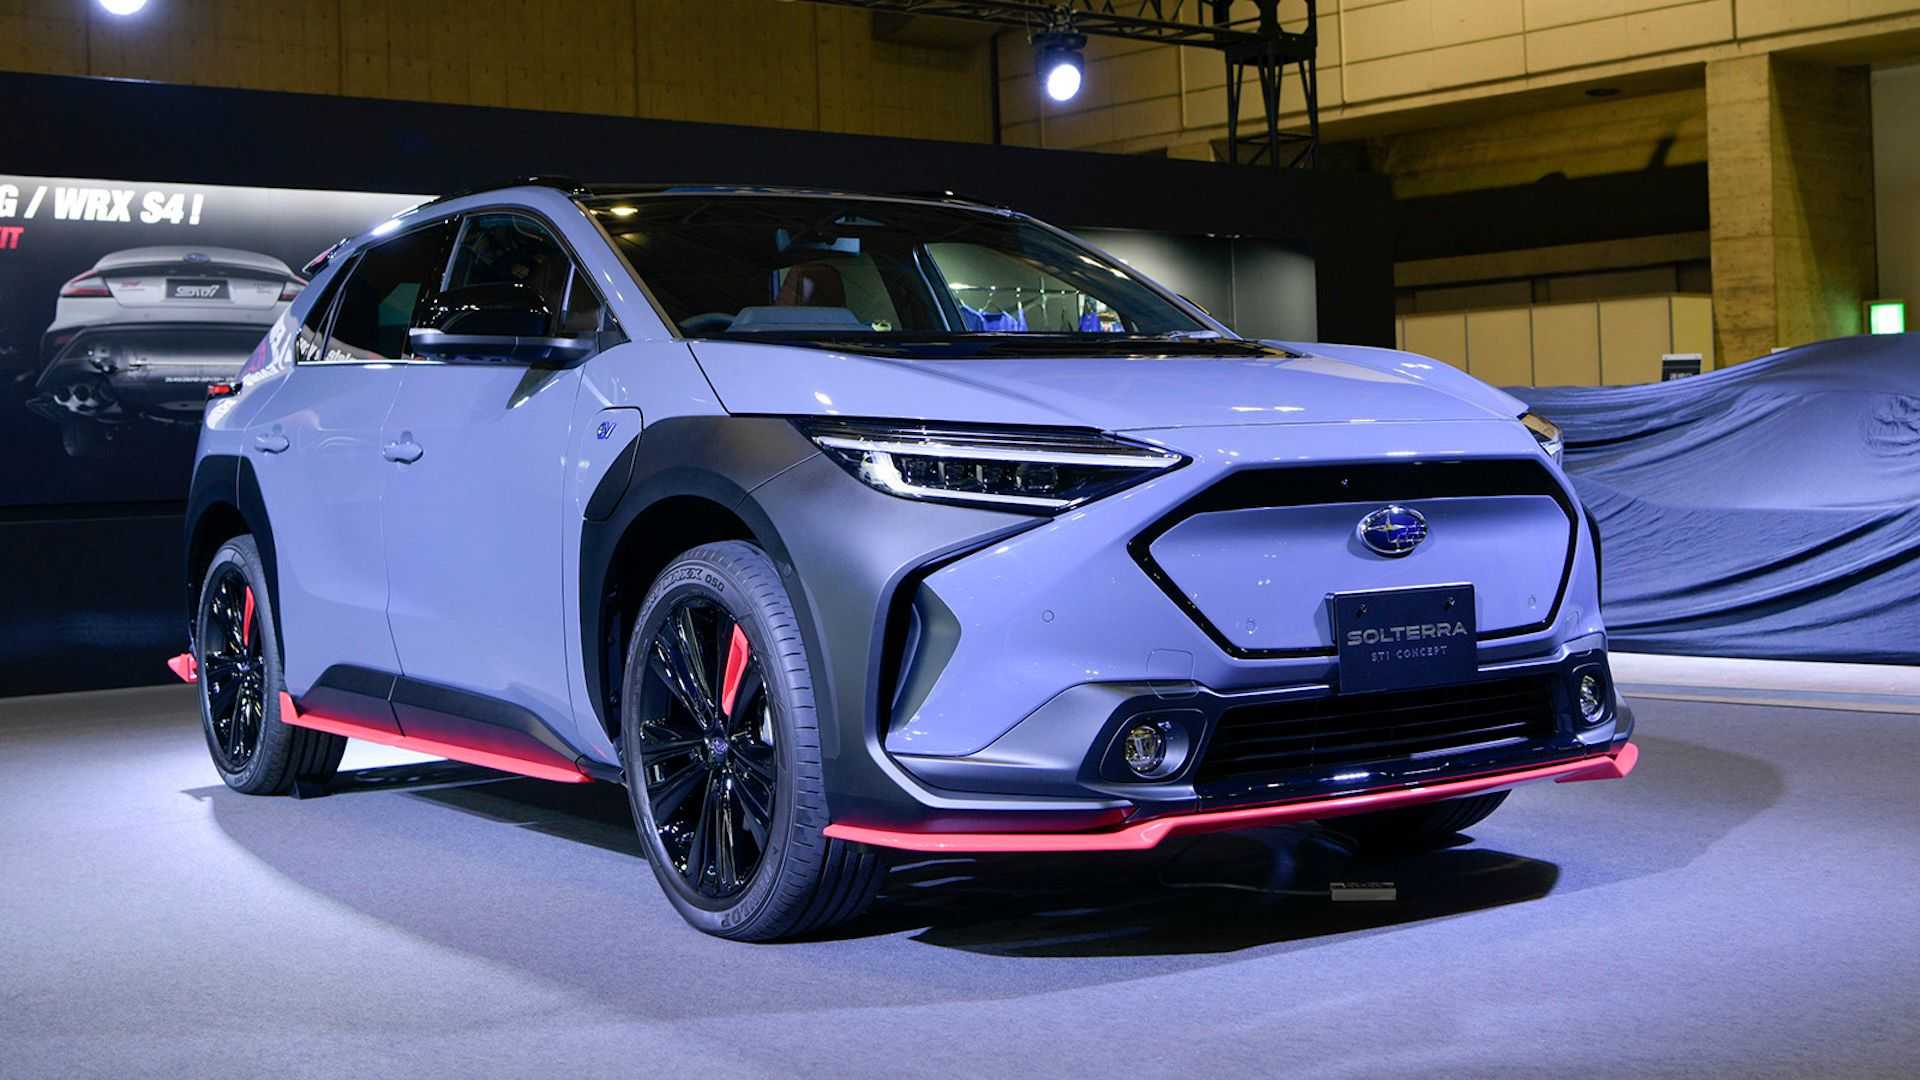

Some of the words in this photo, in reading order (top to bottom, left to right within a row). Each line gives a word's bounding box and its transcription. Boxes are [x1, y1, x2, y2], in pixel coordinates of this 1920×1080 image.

[54, 187, 135, 223] WRX
[0, 226, 24, 250] IT
[1346, 621, 1468, 646] SOLTERRA
[1371, 651, 1390, 662] STI
[1396, 645, 1448, 660] CONCEPT
